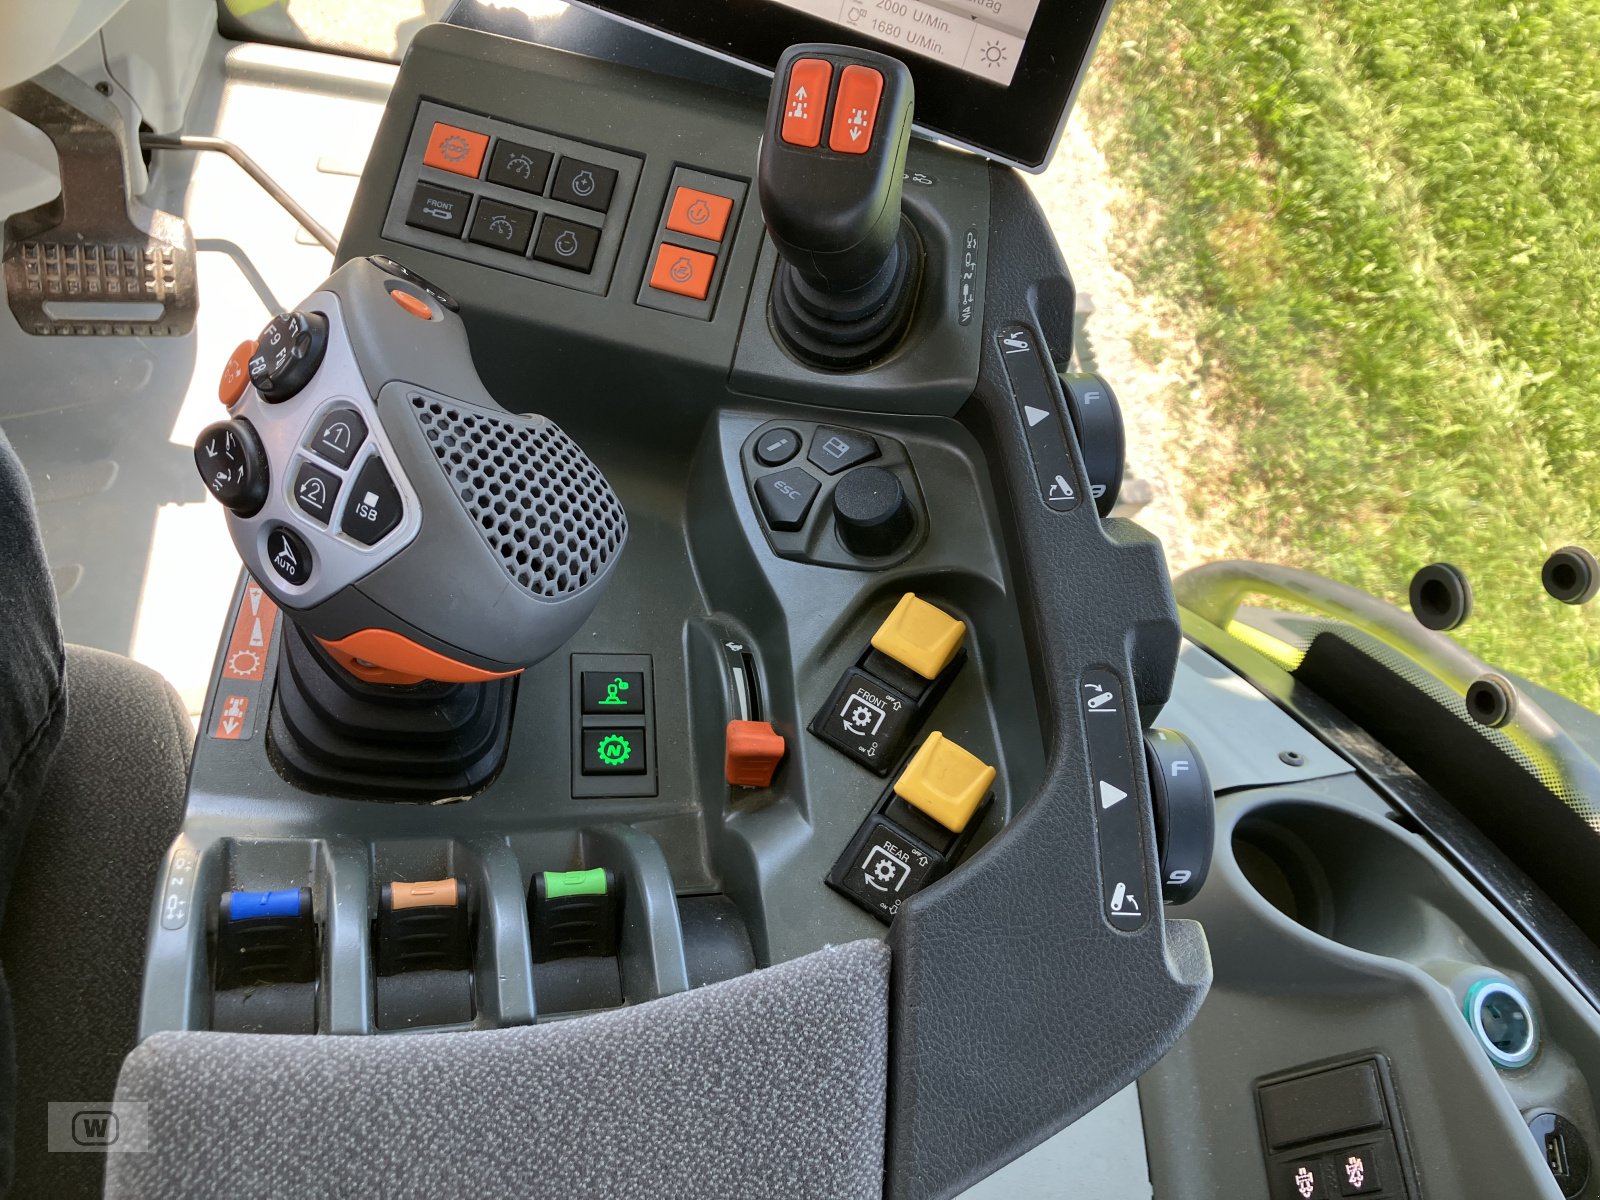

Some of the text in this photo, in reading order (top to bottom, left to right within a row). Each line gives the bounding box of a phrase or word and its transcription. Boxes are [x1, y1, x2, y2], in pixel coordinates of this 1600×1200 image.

[876, 0, 951, 34] 2000 U/Min.
[872, 18, 945, 55] 1680 U/Min.
[427, 198, 454, 210] FRONT
[264, 324, 281, 346] F9
[249, 356, 267, 375] F8
[1084, 391, 1100, 405] F
[334, 428, 343, 443] 1
[308, 482, 320, 501] 2
[774, 480, 801, 500] ESC
[355, 502, 379, 522] ISB
[274, 555, 296, 576] AUTO
[857, 687, 887, 710] FRONT
[885, 694, 896, 703] OFF
[606, 744, 622, 757] N
[1171, 760, 1189, 777] F
[883, 840, 910, 863] REAR
[911, 848, 922, 857] OFF
[1166, 869, 1192, 885] 9
[880, 902, 888, 910] ON
